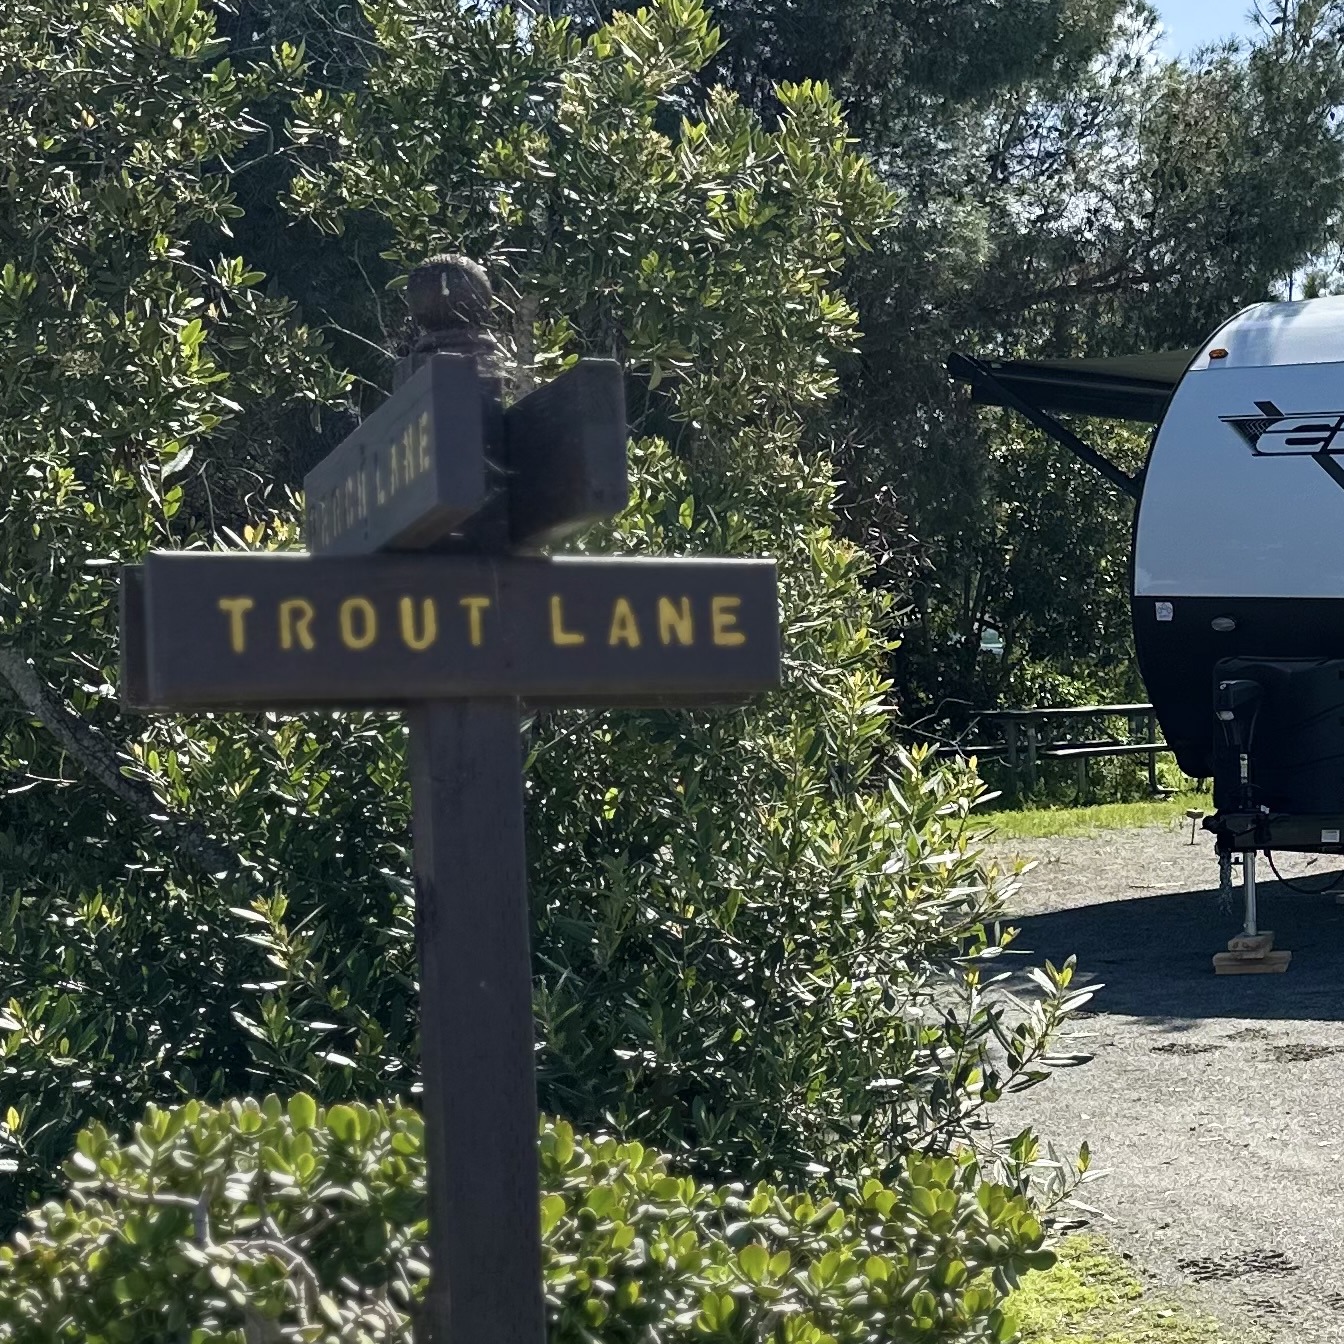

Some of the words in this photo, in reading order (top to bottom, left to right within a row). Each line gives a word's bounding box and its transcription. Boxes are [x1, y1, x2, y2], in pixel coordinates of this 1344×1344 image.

[375, 411, 430, 505] LANE
[219, 597, 489, 652] TROUT
[552, 596, 746, 647] LANE
